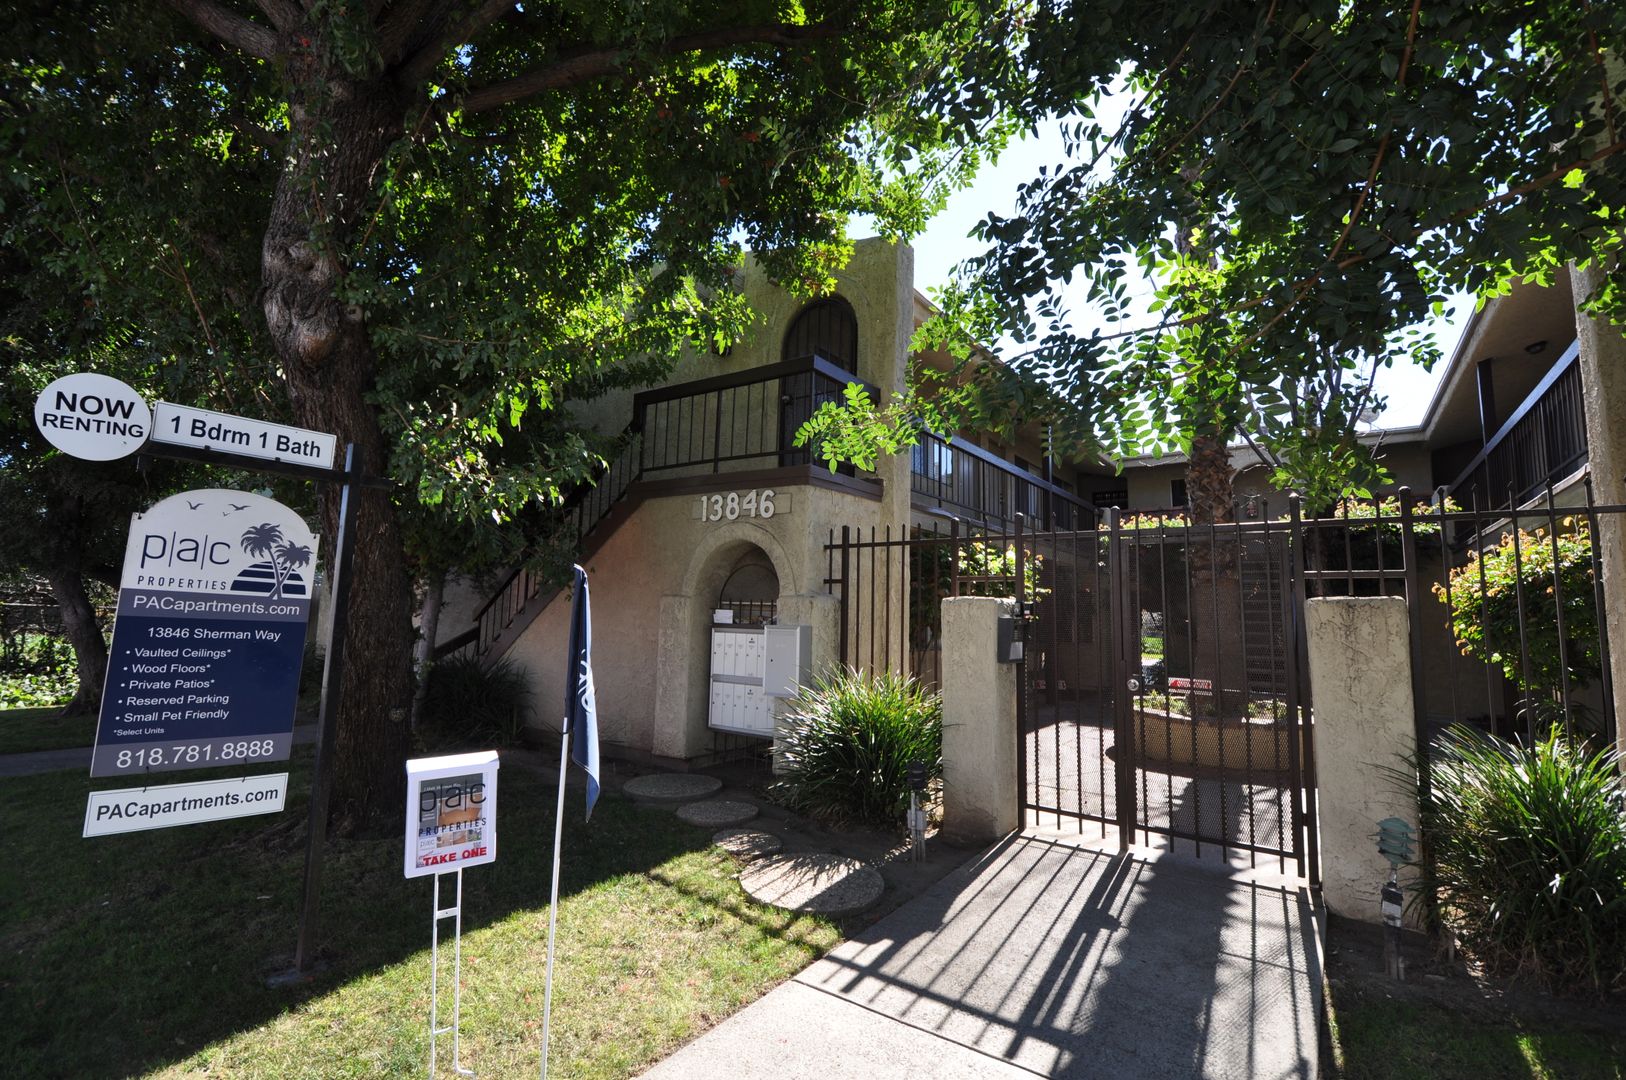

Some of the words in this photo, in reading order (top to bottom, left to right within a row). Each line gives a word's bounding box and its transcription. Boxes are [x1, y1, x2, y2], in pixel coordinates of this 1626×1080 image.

[55, 391, 135, 419] NOW
[42, 413, 144, 438] RENTING
[170, 416, 181, 434] 1
[190, 419, 250, 446] Bdrm
[258, 431, 268, 449] 1
[275, 435, 321, 458] Bath
[700, 489, 775, 522] 13846
[137, 575, 227, 591] PROPERTIES
[133, 595, 300, 615] PACapartments.com
[148, 627, 190, 639] 13846
[194, 628, 251, 640] Sherman
[254, 630, 281, 642] Way
[134, 648, 179, 658] Vaulted
[131, 664, 168, 673] Wood
[129, 680, 171, 690] Private
[126, 696, 184, 706] Reserved
[187, 695, 229, 706] Parking
[123, 712, 158, 723] Small
[162, 712, 183, 721] Pet
[185, 710, 229, 721] Friendly
[145, 727, 165, 735] Units
[116, 740, 274, 768] 818.781.8888
[96, 788, 279, 821] PACapartments.com
[418, 818, 487, 837] PROPERTIES
[422, 852, 457, 866] TAKE
[461, 847, 487, 859] ONE
